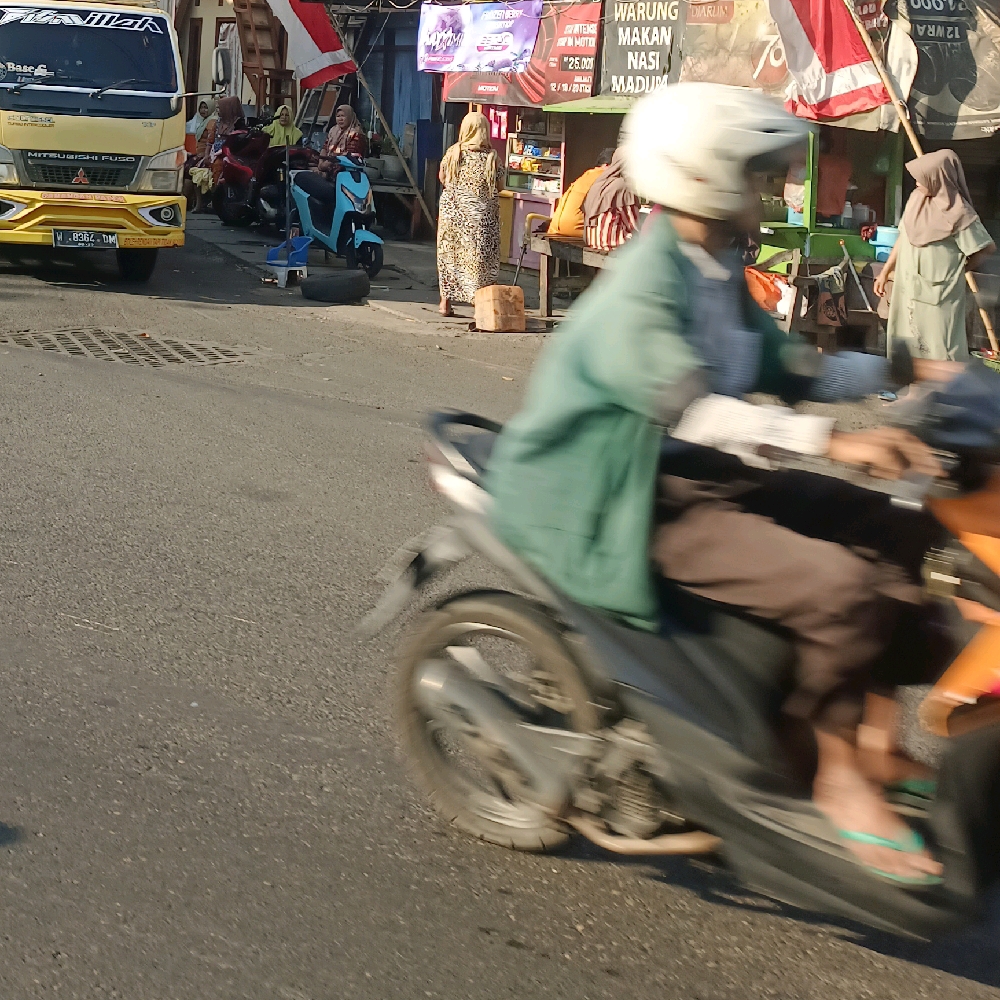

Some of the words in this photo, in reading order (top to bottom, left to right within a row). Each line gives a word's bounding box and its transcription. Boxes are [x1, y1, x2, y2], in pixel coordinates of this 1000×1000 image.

[614, 1, 679, 21] WARUNG
[618, 26, 672, 46] MAKAN
[627, 51, 660, 70] NASI
[28, 151, 98, 161] MITSUBISHI
